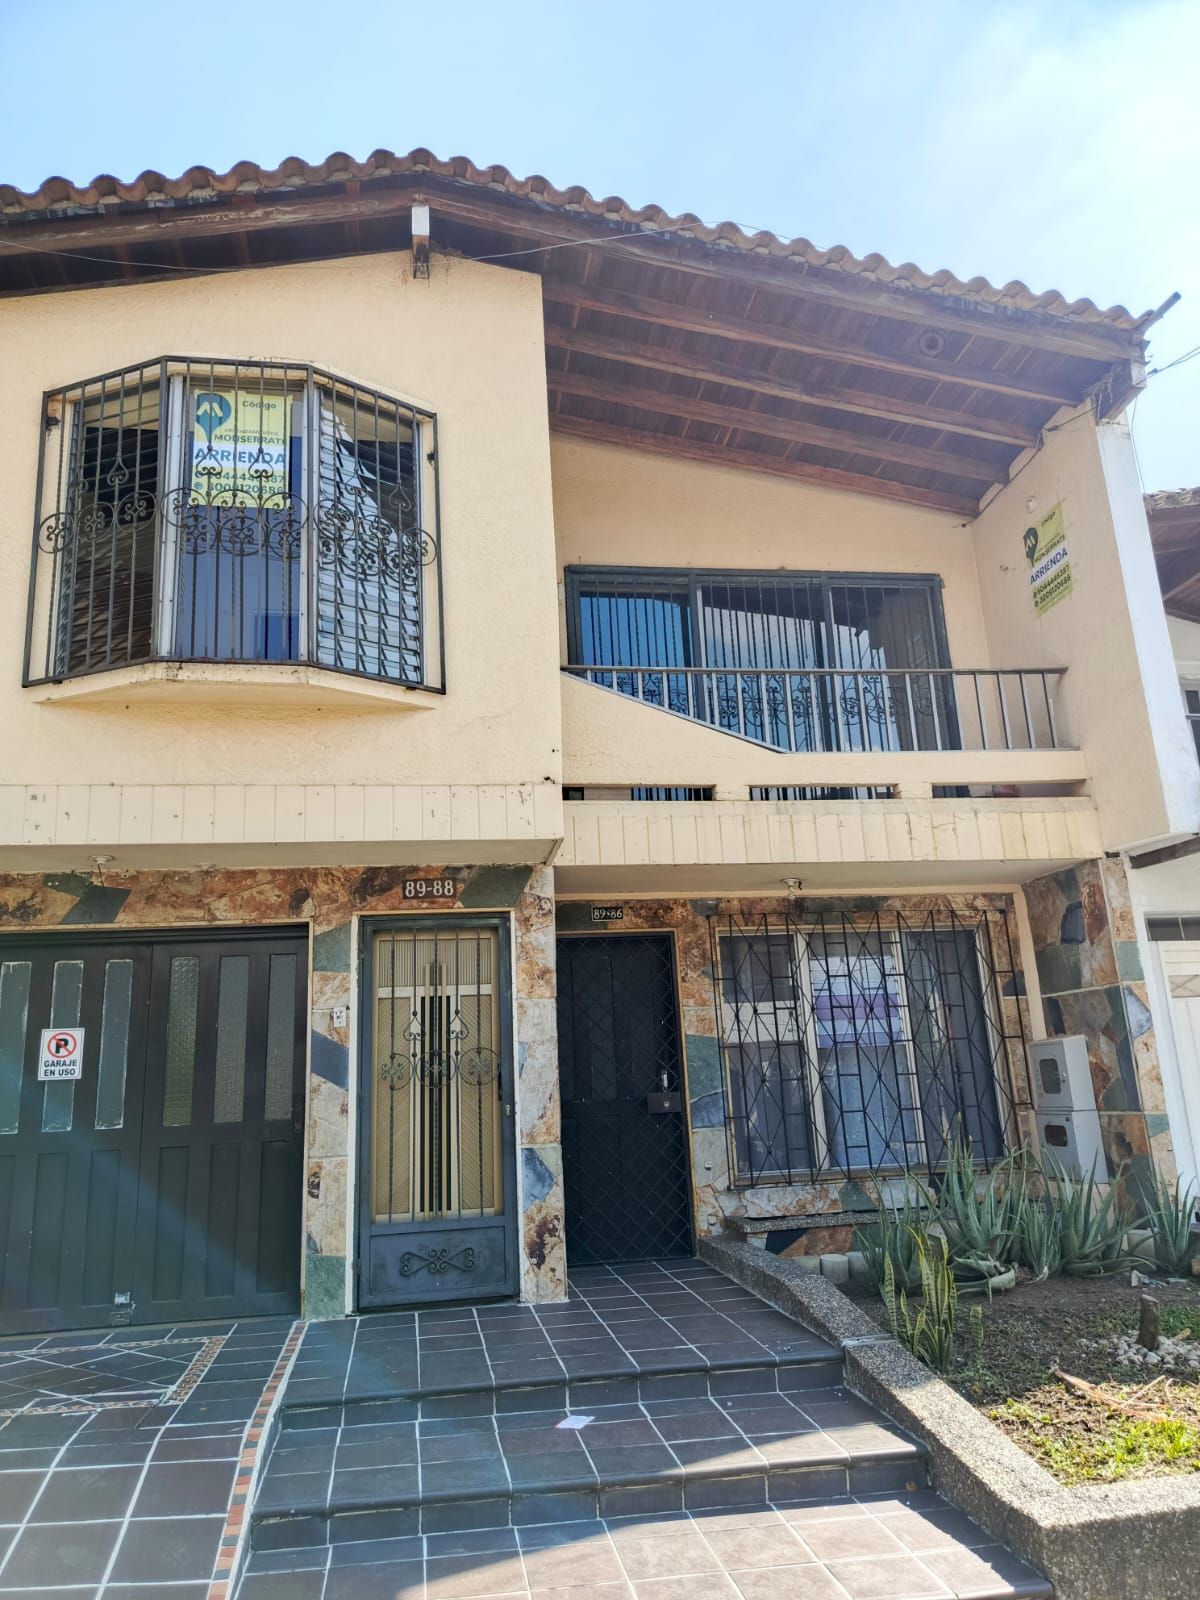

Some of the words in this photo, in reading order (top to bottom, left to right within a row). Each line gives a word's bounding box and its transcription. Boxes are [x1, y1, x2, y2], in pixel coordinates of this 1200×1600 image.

[195, 448, 286, 464] ARRENDA
[1030, 547, 1068, 585] ARRIENDA
[405, 880, 454, 897] 89-88
[593, 908, 623, 919] 89-86
[44, 1060, 77, 1068] GARAJE
[44, 1069, 56, 1077] EN
[58, 1068, 76, 1076] USO
